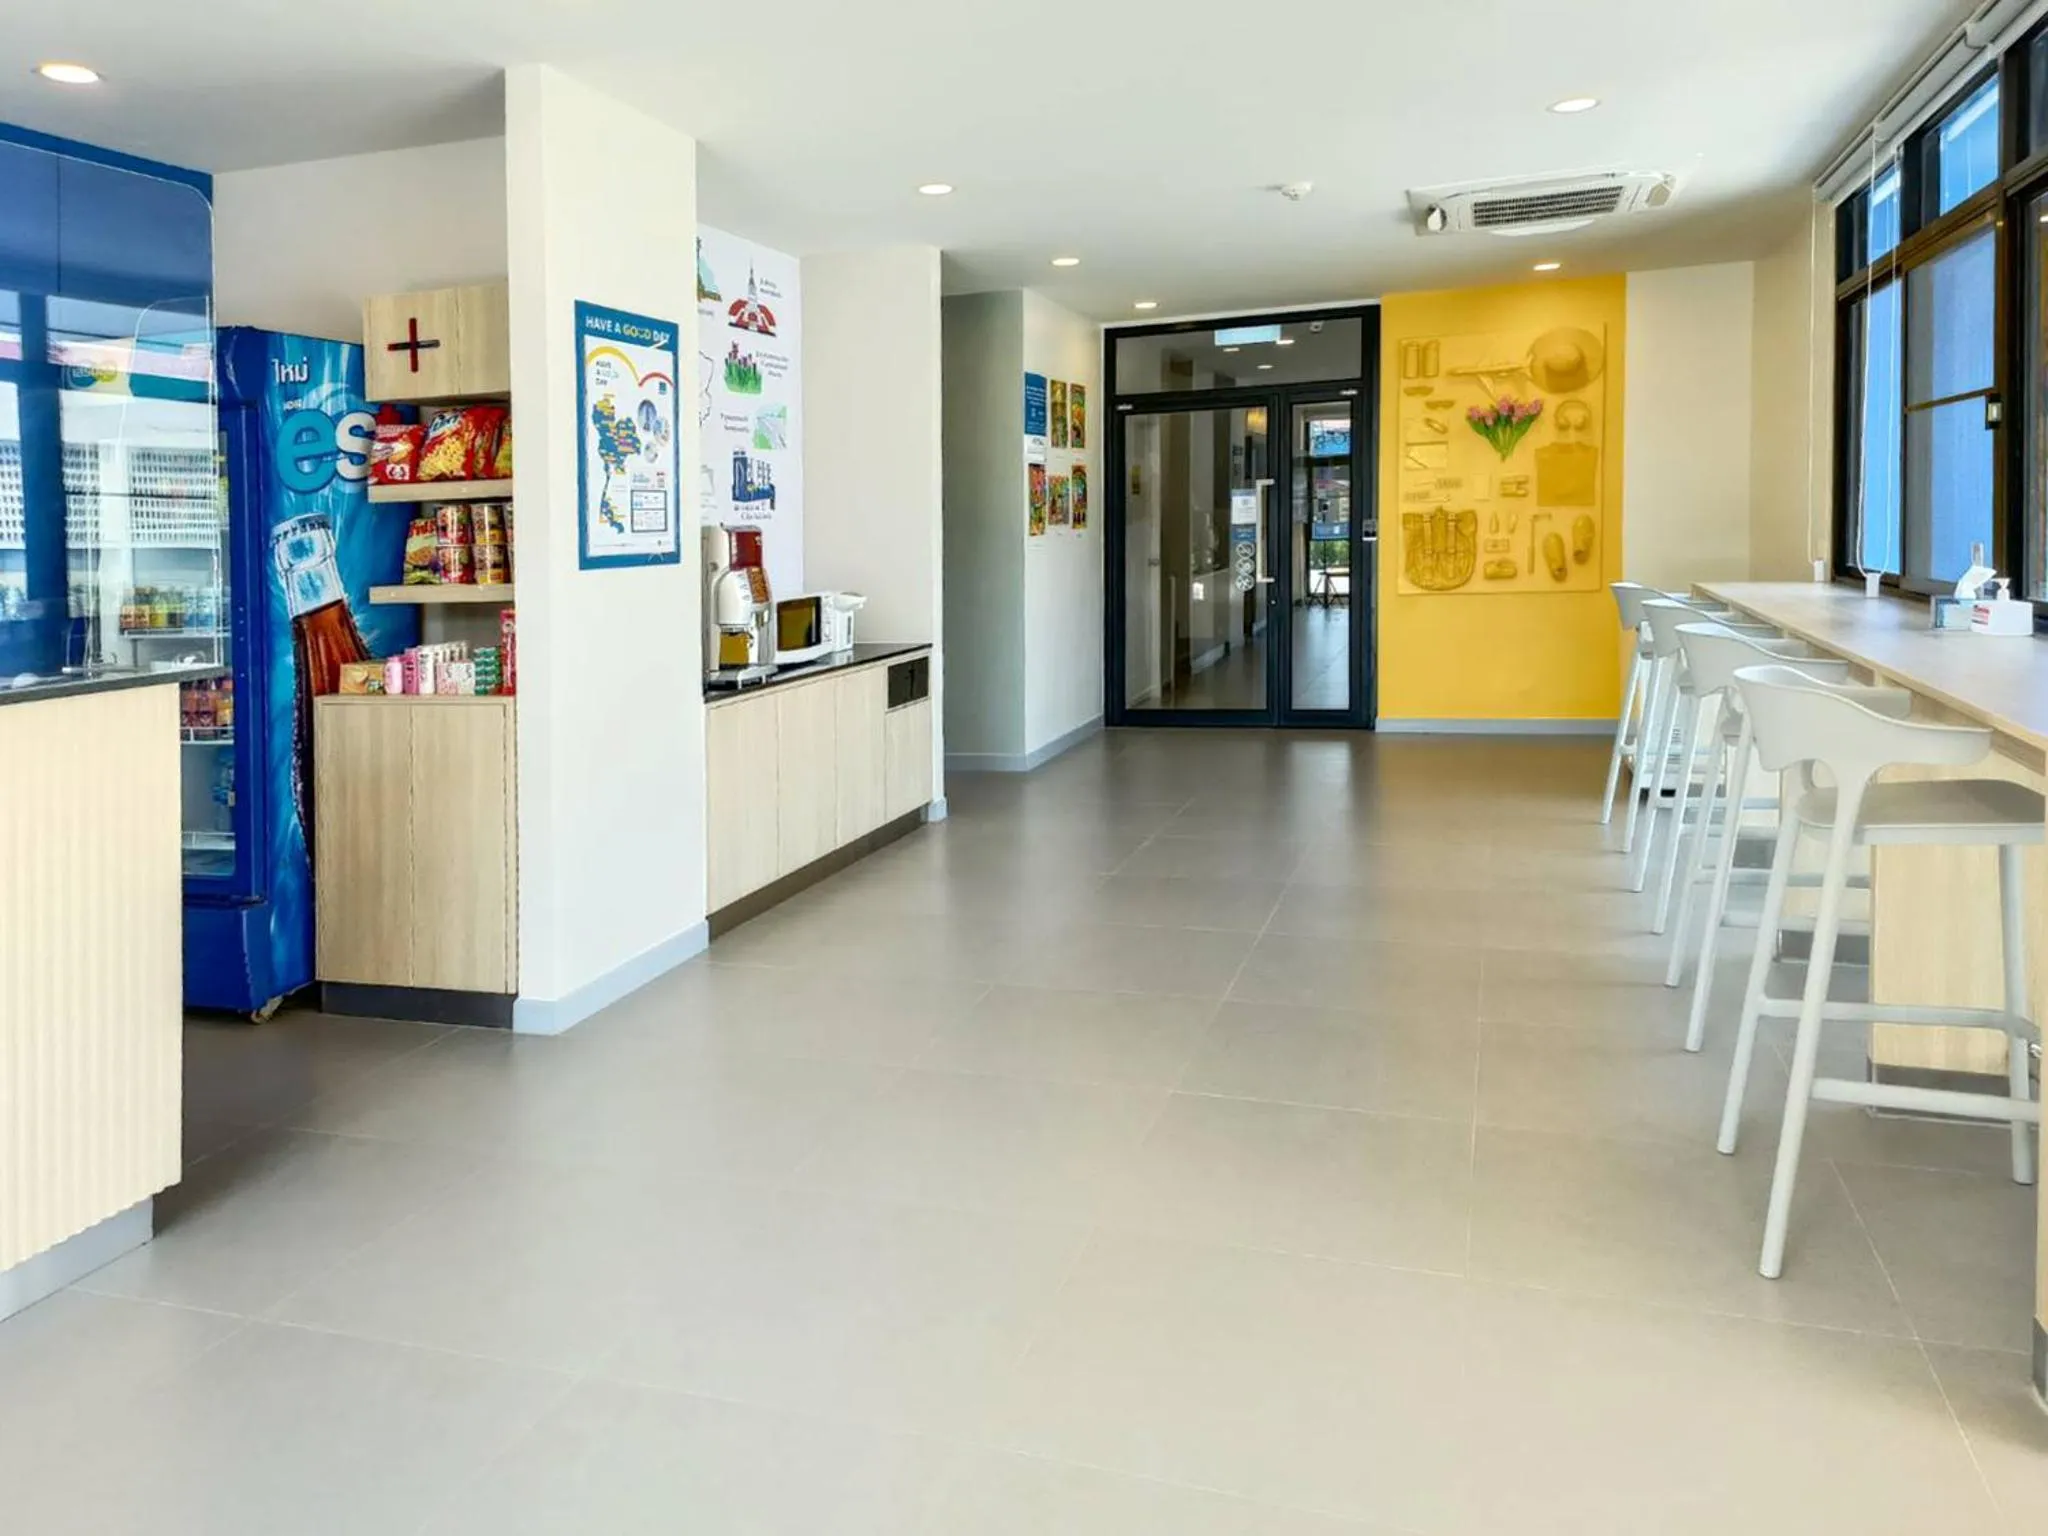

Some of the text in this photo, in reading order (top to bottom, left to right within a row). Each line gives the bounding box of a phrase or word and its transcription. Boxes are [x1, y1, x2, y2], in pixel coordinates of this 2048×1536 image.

[585, 315, 613, 333] HAVE
[615, 322, 621, 335] A
[276, 409, 376, 495] es
